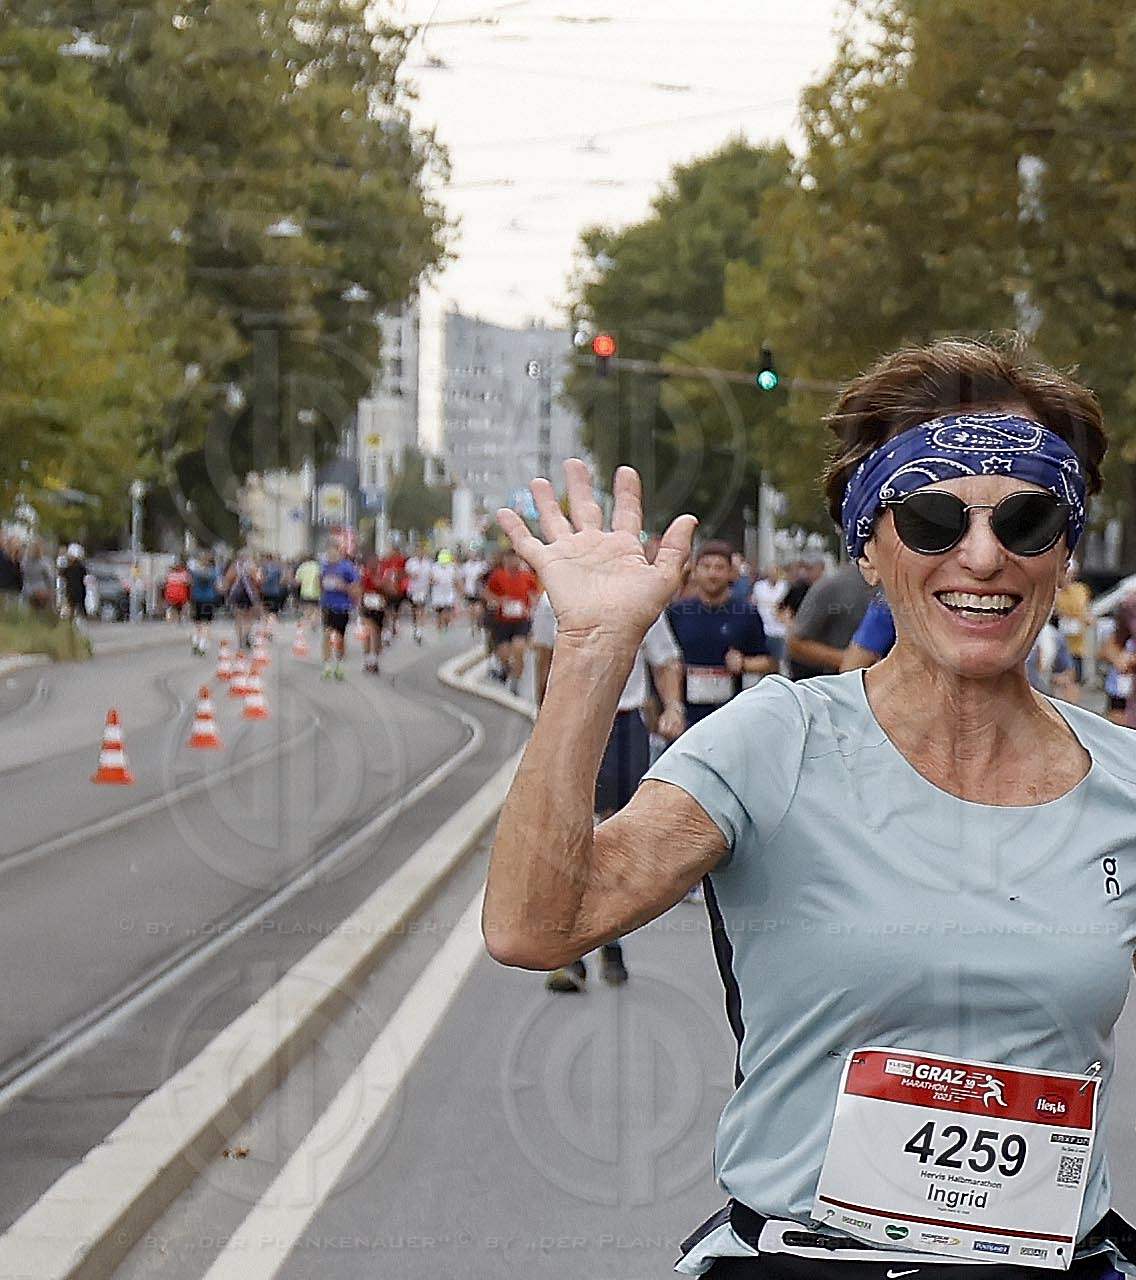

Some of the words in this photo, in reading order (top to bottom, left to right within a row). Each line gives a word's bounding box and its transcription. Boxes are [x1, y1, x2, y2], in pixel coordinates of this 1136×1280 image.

[915, 1064, 967, 1085] GRAZ
[901, 1078, 949, 1093] MARATHON
[903, 1120, 1027, 1177] 4259
[920, 1170, 946, 1181] Hervis
[948, 1174, 1002, 1189] Halbmarathon
[927, 1183, 988, 1208] Ingrid
